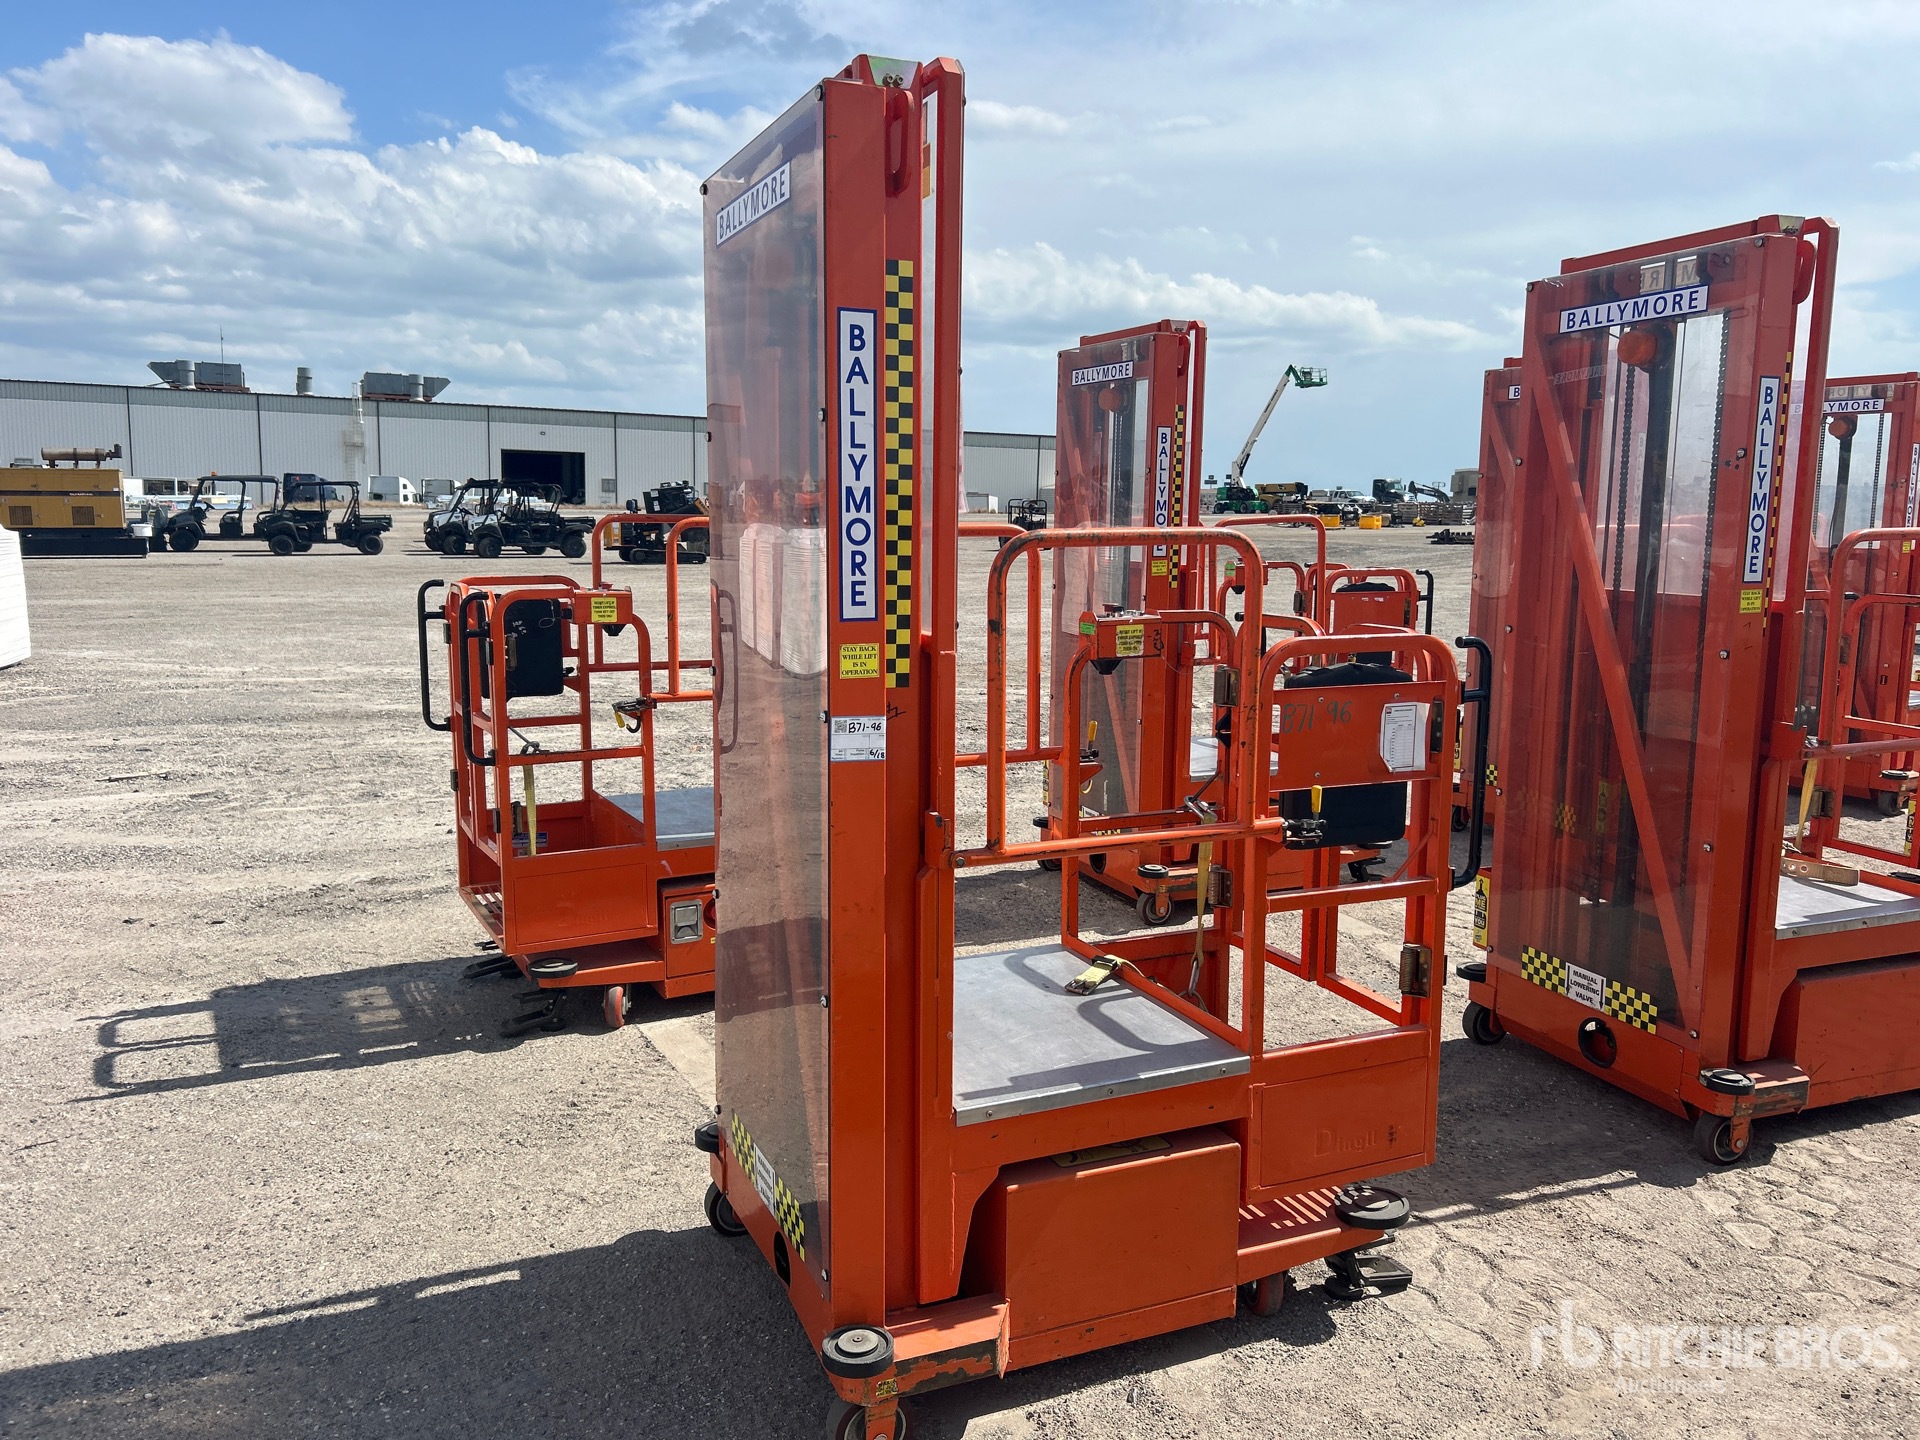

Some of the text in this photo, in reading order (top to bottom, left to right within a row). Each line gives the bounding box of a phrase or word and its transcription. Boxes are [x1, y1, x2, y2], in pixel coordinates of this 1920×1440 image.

[719, 169, 786, 240] BALLYMORE
[1566, 289, 1700, 331] BALLYMORE
[1074, 363, 1130, 384] BALLYMORE
[845, 323, 872, 607] BALLYMORE
[1748, 385, 1774, 574] BALLYMORE
[848, 721, 882, 733] B71-96
[1570, 979, 1600, 996] LOWERING
[1572, 970, 1598, 985] MANUAL
[1575, 991, 1594, 1004] VALVE
